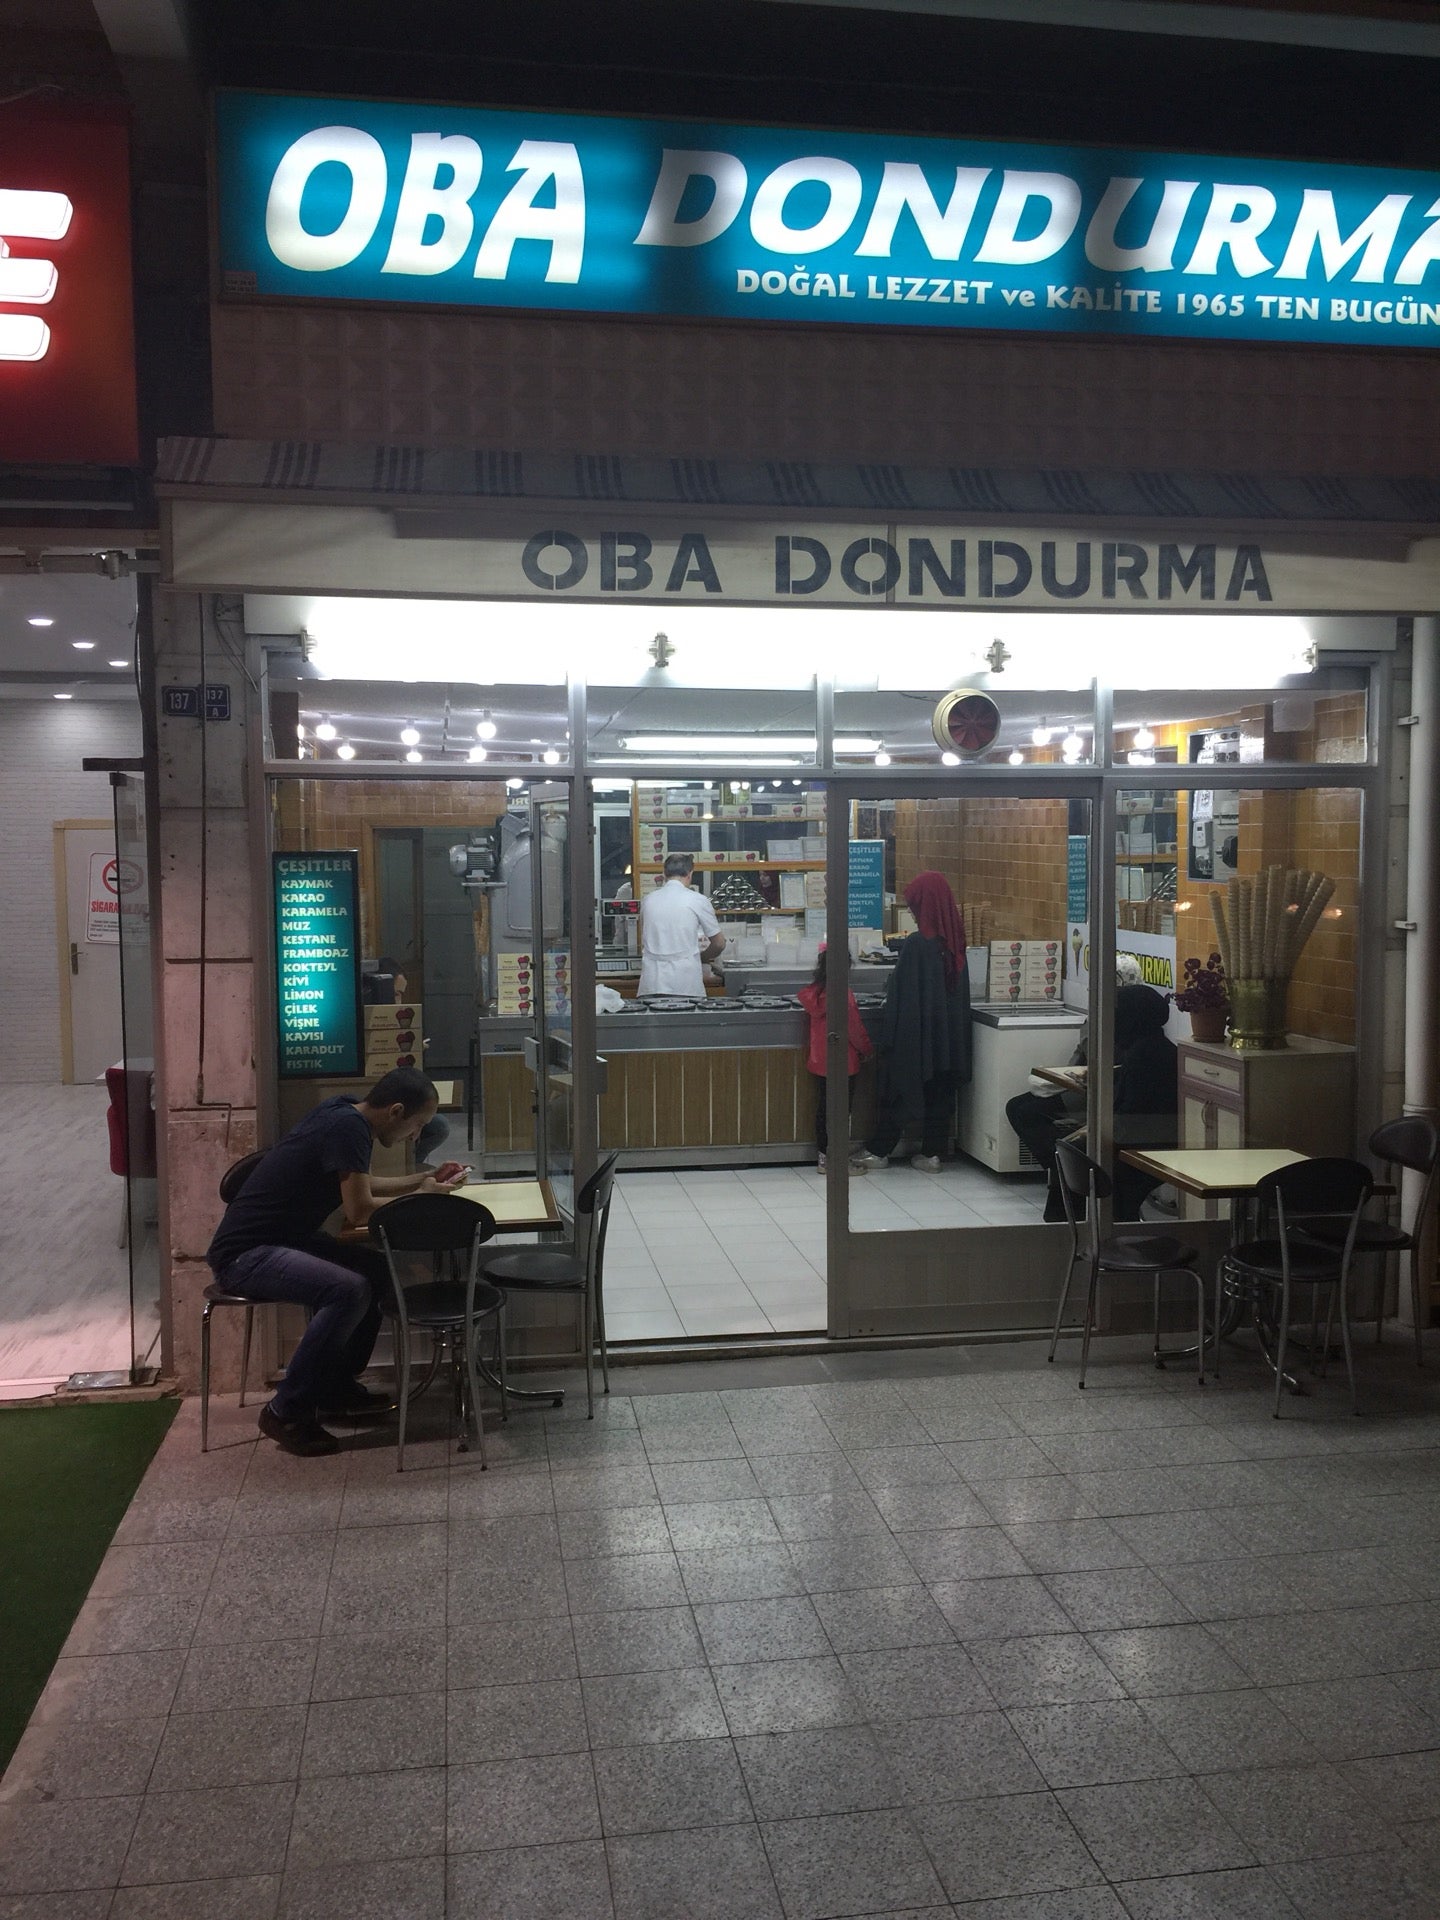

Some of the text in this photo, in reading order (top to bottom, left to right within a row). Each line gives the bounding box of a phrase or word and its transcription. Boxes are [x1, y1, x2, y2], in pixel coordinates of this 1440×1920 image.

[265, 125, 586, 285] OBA
[736, 264, 856, 299] DOĞAL
[867, 275, 994, 305] LEZZET
[1001, 288, 1036, 308] ve
[1046, 281, 1163, 314] KALİTE
[1176, 293, 1245, 318] 1965
[1255, 296, 1320, 321] TEN
[521, 529, 1274, 602] OBA DONDURMA
[207, 689, 223, 700] 137
[169, 692, 190, 710] 137
[212, 707, 219, 717] A
[278, 857, 352, 875] ÇEŞİTLER
[281, 879, 334, 889] KAYMAK
[281, 893, 325, 903] KAKAO
[282, 907, 348, 917] KARAMELA
[282, 921, 311, 931] MUZ
[282, 934, 336, 945] KESTANE
[283, 948, 349, 959] FRAMBOAZ
[283, 962, 338, 973] KOKTEYL
[283, 974, 310, 987] KİVİ
[284, 988, 325, 1001] LİMON
[284, 1002, 318, 1017] ÇİLEK
[284, 1016, 320, 1030] VİŞNE
[285, 1031, 324, 1042] KAYISI
[286, 1045, 345, 1056] KARADUT
